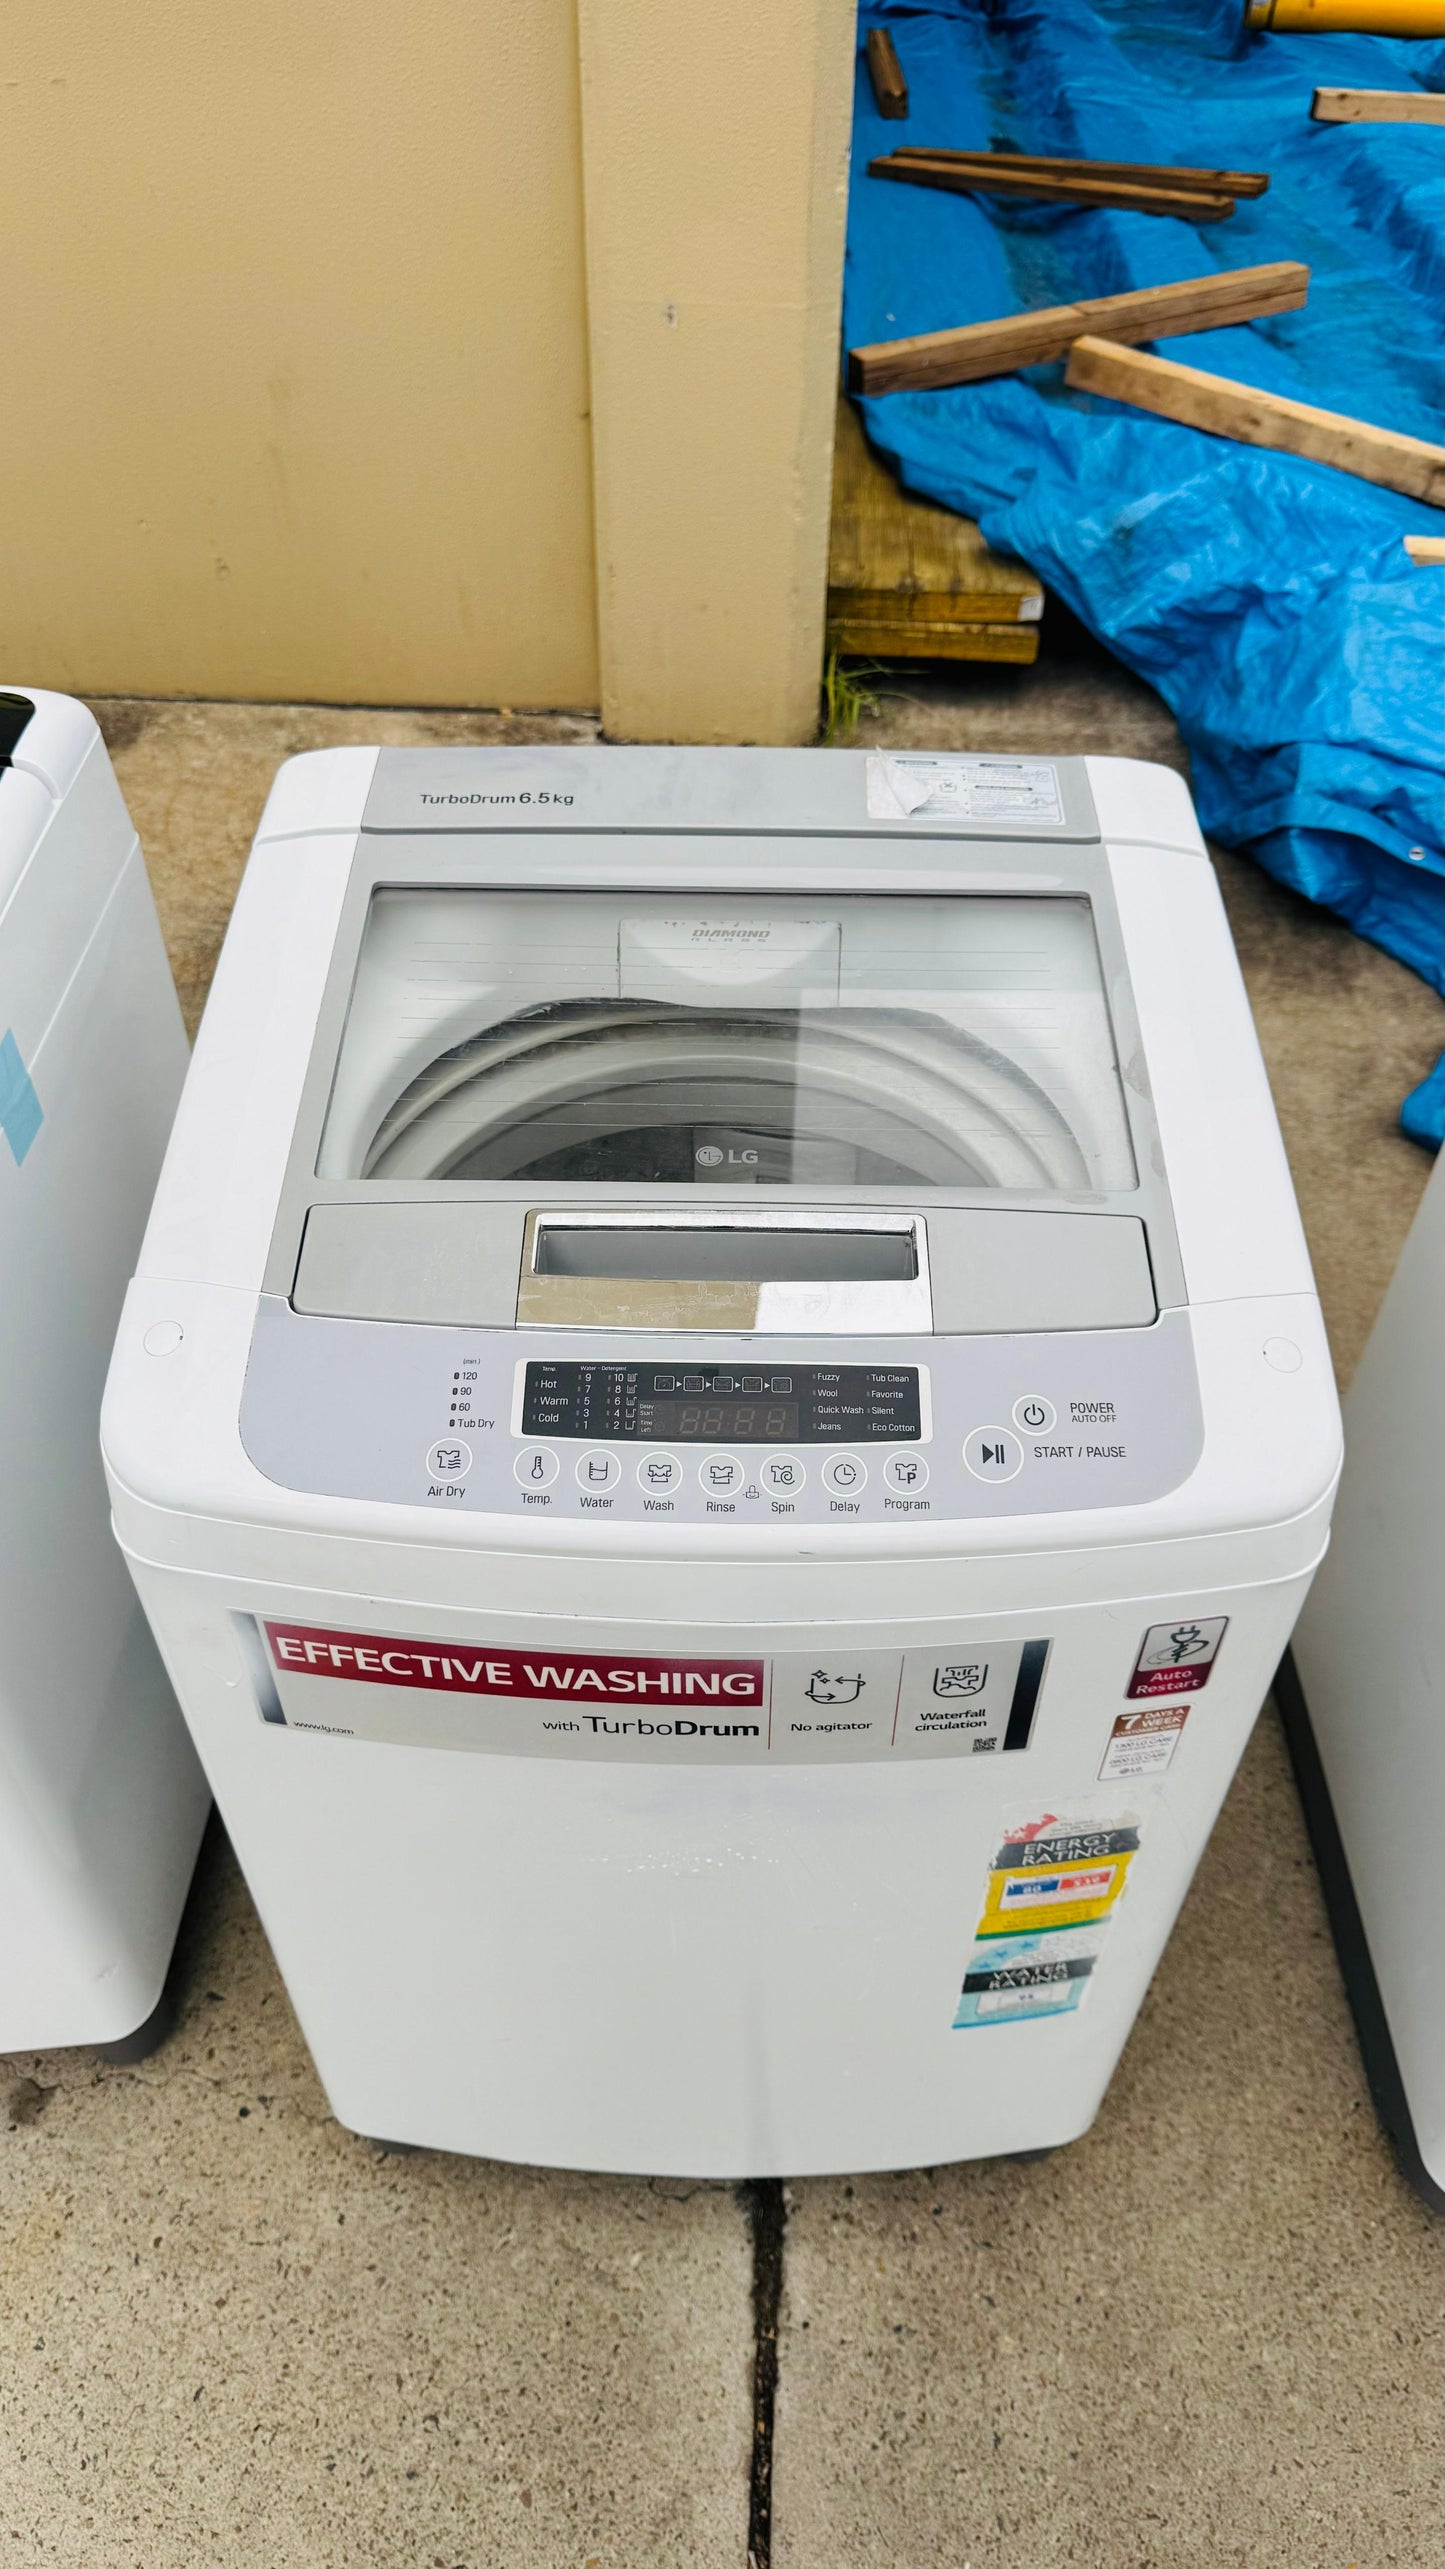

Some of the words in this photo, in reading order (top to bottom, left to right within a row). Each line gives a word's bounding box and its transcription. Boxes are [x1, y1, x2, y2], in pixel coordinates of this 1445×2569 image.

[420, 794, 516, 804] TurboDrum
[519, 792, 550, 804] 6.5
[553, 794, 574, 806] kg
[692, 929, 771, 938] DIAMOND
[728, 1149, 758, 1164] LG
[462, 1371, 477, 1380] 120
[585, 1373, 591, 1381] 9
[614, 1373, 624, 1381] 10
[817, 1373, 840, 1383] Fuzzy
[871, 1374, 885, 1382] Tub
[887, 1374, 910, 1382] Clean
[541, 1380, 557, 1388] Hot
[585, 1385, 591, 1393] 7
[615, 1385, 621, 1393] 8
[460, 1387, 471, 1396] 90
[817, 1389, 838, 1398] Wool
[871, 1390, 904, 1399] Favorite
[540, 1397, 568, 1405] Warm
[584, 1397, 590, 1405] 5
[614, 1397, 620, 1405] 6
[458, 1403, 471, 1412] 60
[817, 1405, 840, 1415] Quick
[841, 1405, 864, 1414] Wash
[871, 1406, 894, 1415] Silent
[1070, 1402, 1115, 1414] POWER
[538, 1414, 559, 1422] Cold
[583, 1409, 590, 1417] 3
[614, 1409, 620, 1417] 4
[458, 1419, 475, 1428] Tub
[477, 1419, 495, 1429] Dry
[1072, 1415, 1098, 1423] AUTO
[1099, 1415, 1117, 1423] OFF
[584, 1421, 588, 1429] 1
[613, 1421, 620, 1429] 2
[817, 1422, 841, 1431] Jeans
[872, 1423, 885, 1431] Eco
[887, 1423, 915, 1432] Cotton
[1034, 1446, 1074, 1458] START
[1086, 1446, 1127, 1458] PAUSE
[427, 1486, 445, 1497] Air
[446, 1486, 466, 1498] Dry
[520, 1493, 553, 1505] Temp.
[580, 1497, 614, 1508] Water
[643, 1500, 675, 1511] Wash
[706, 1501, 735, 1512] Rinse
[771, 1501, 795, 1514] Spin
[830, 1501, 860, 1514] Delay
[884, 1498, 930, 1512] Program
[277, 1637, 514, 1687] EFFECTIVE
[522, 1664, 755, 1697] WASHING
[1150, 1669, 1192, 1682] Auto
[1136, 1678, 1201, 1694] Restart
[920, 1708, 986, 1720] Waterfall
[542, 1718, 580, 1732] with
[582, 1715, 761, 1737] TurboDrum
[914, 1719, 988, 1732] circulation
[1121, 1715, 1142, 1730] 7
[1141, 1716, 1182, 1727] WEEK
[292, 1719, 355, 1736] www.lg.com
[790, 1723, 812, 1732] No
[815, 1721, 872, 1733] agitator
[1024, 1832, 1117, 1854] ENERGY
[1022, 1844, 1111, 1865] RATING
